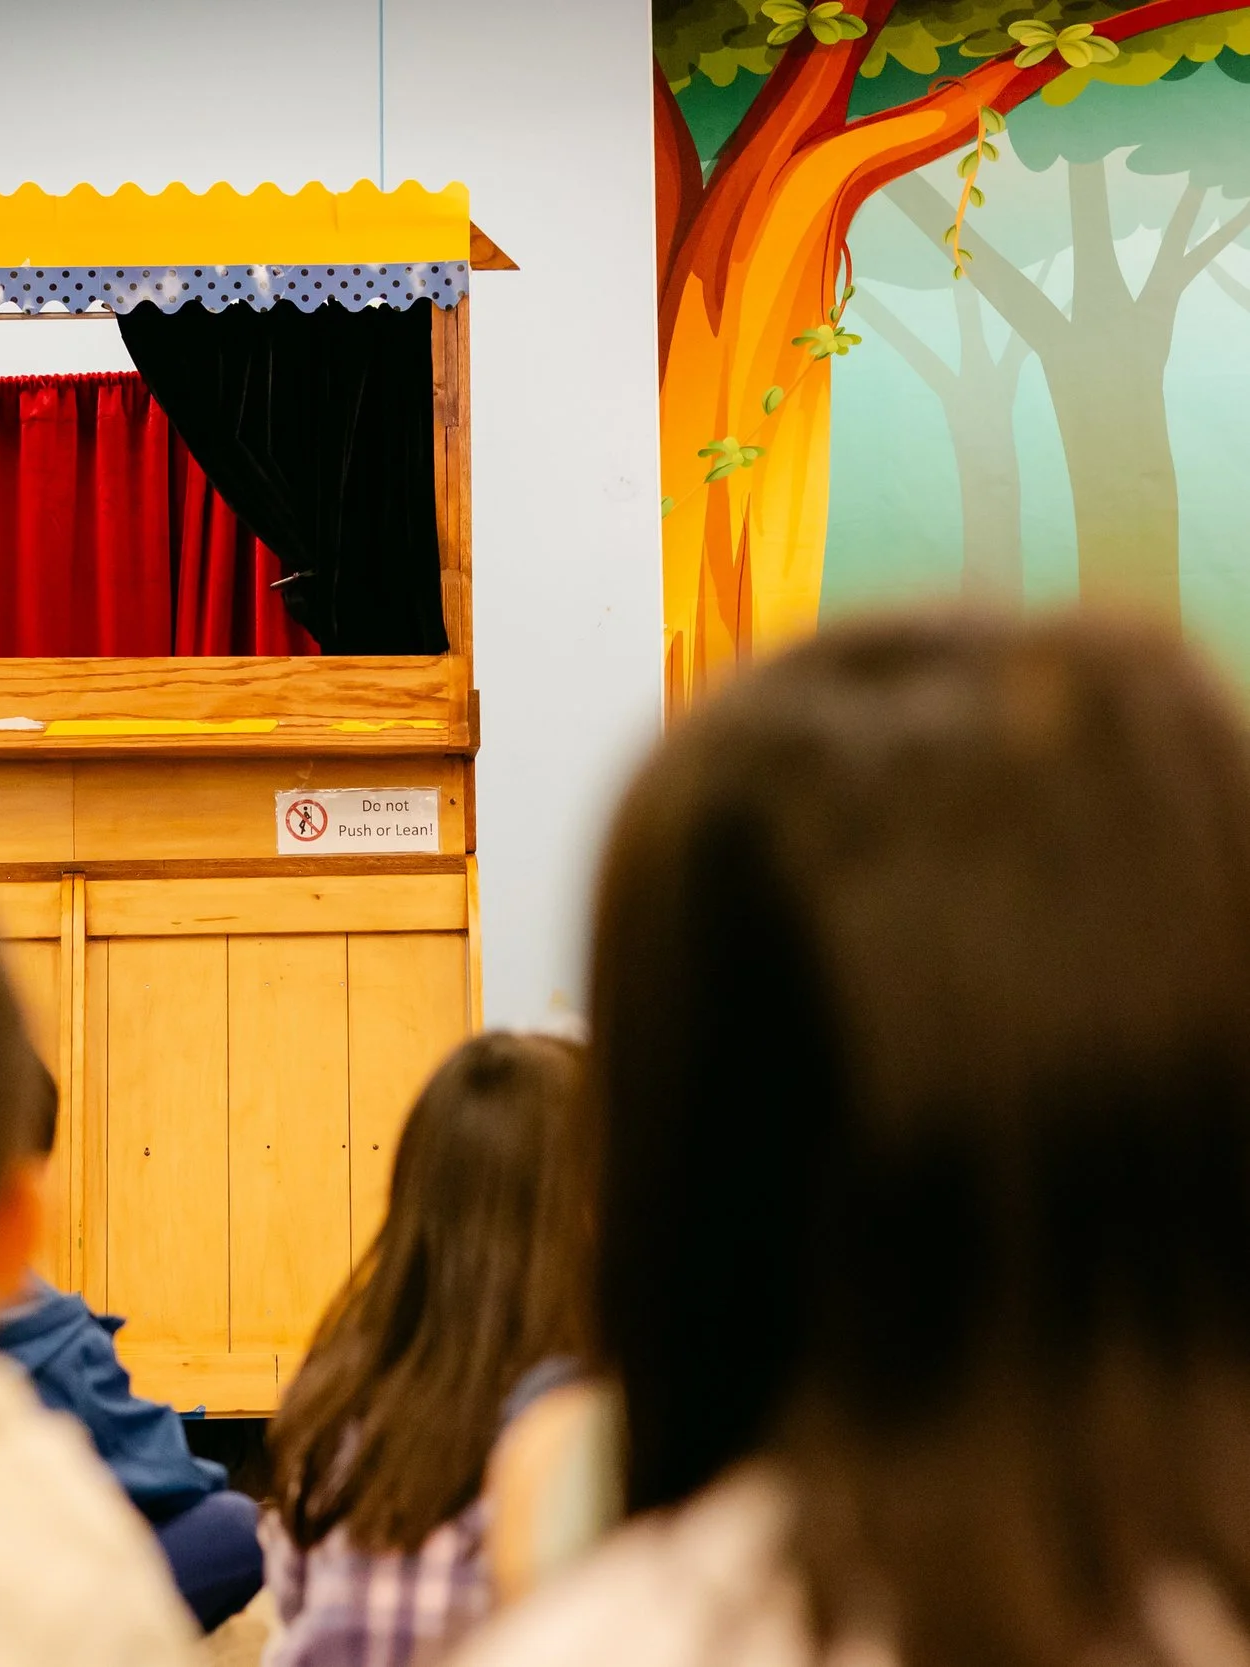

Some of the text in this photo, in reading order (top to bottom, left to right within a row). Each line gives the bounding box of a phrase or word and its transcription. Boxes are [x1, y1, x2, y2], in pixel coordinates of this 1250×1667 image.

[362, 800, 410, 812] Do not
[339, 823, 433, 837] Push or Lean!
